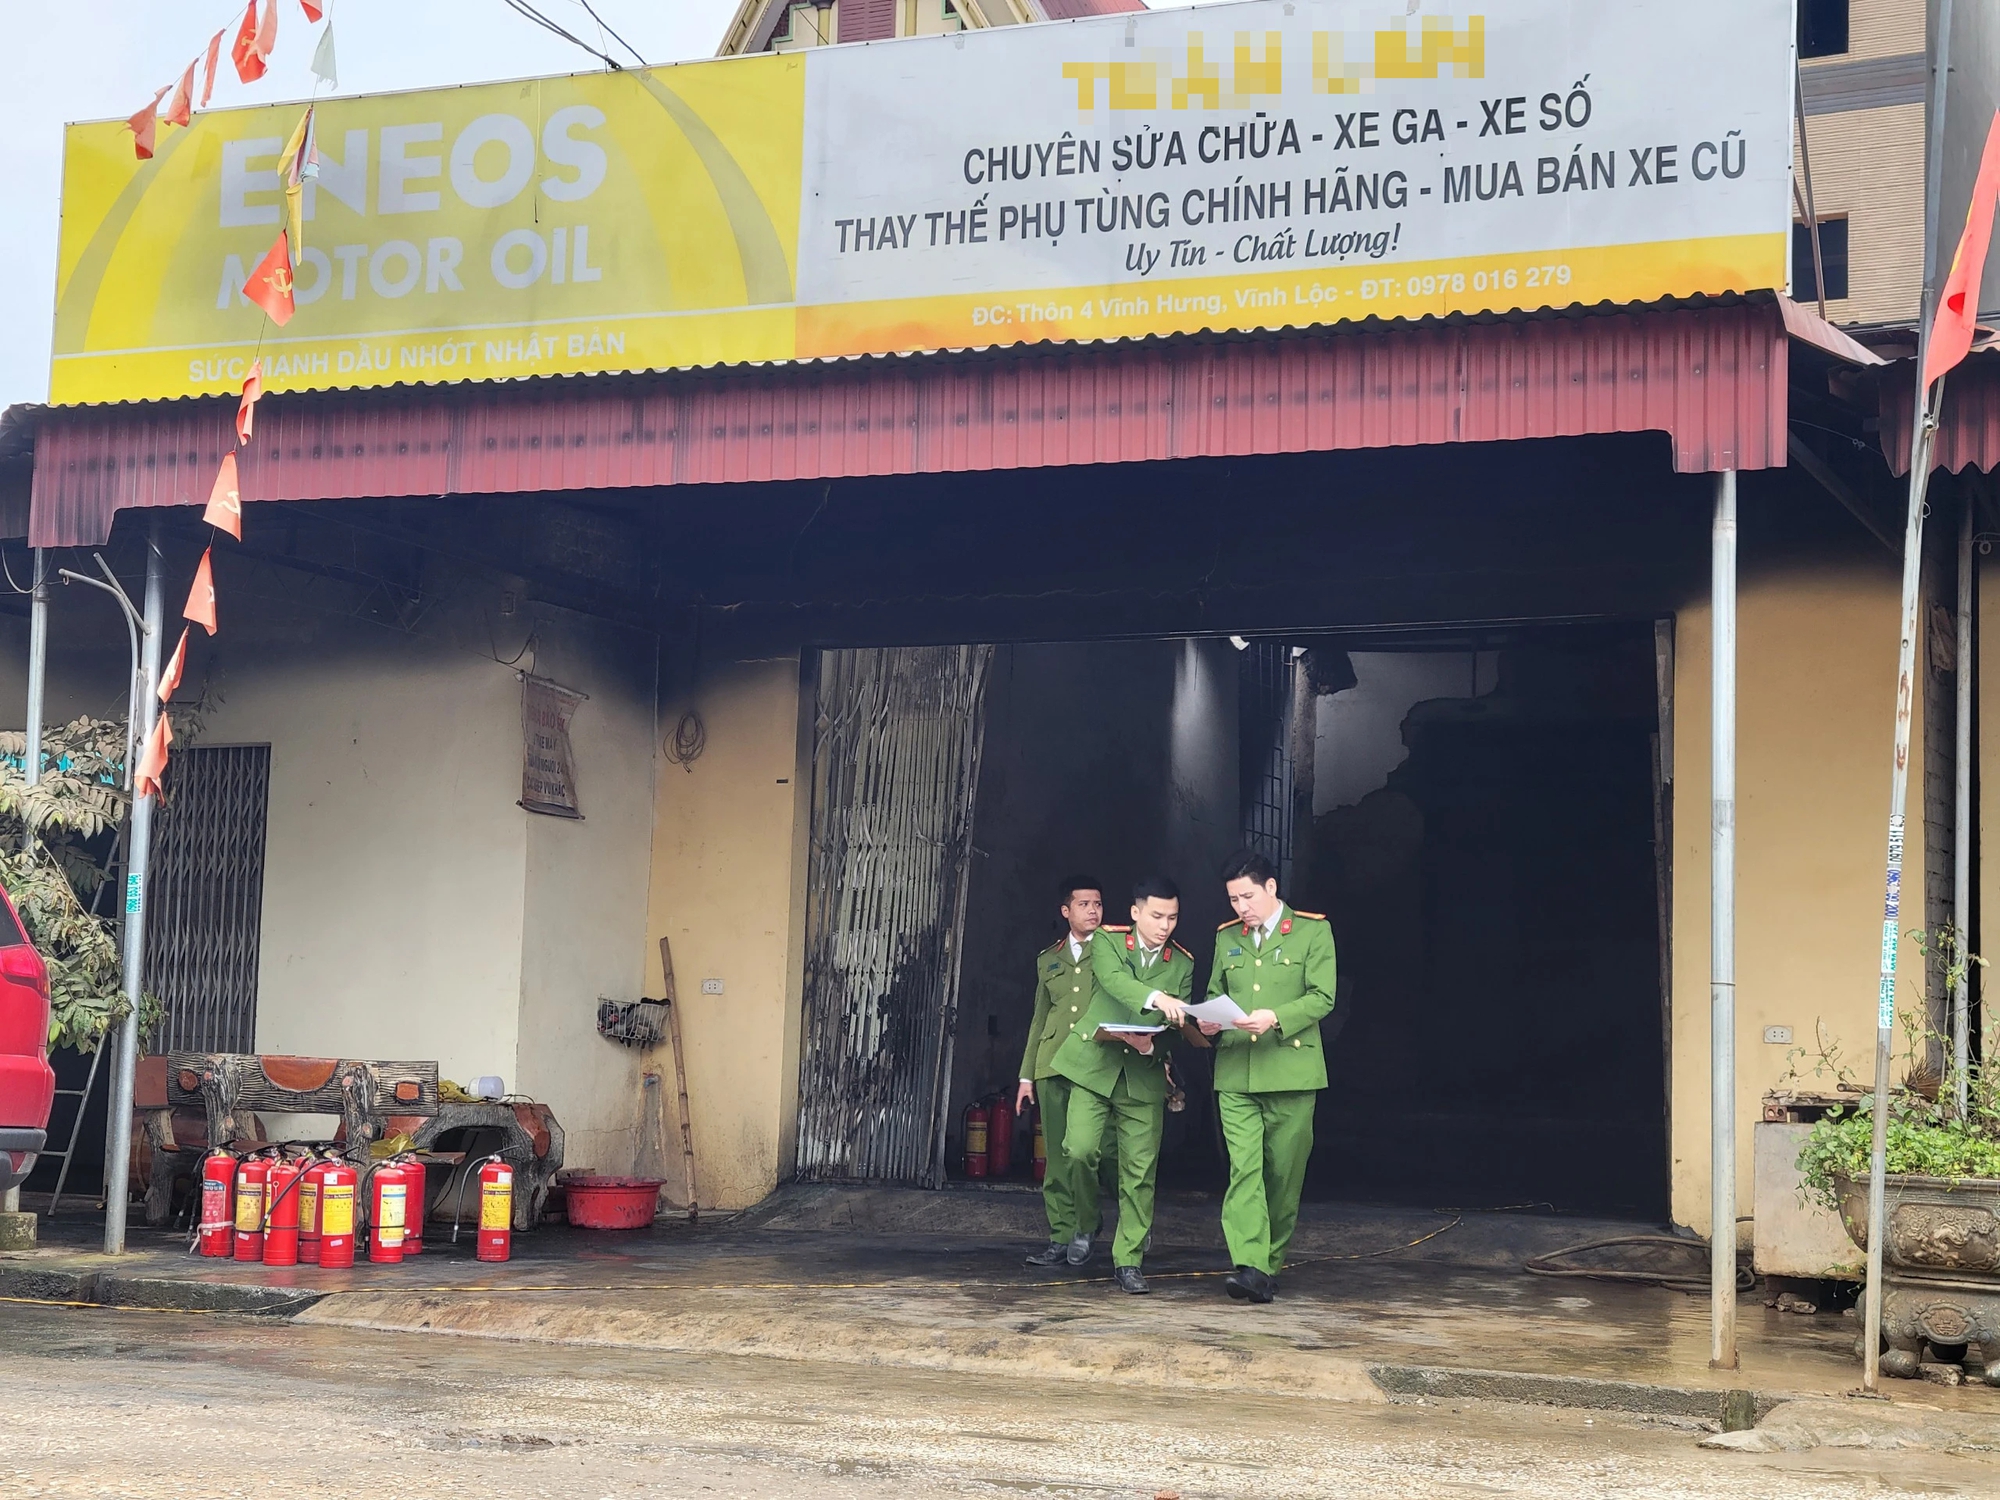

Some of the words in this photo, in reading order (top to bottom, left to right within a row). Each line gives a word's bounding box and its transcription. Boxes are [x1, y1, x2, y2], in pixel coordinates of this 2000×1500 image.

[218, 104, 608, 228] ENEOS
[963, 131, 1101, 185] CHUYÊN
[1111, 124, 1188, 172] SỬA
[1198, 111, 1302, 164] CHỮA
[1333, 111, 1380, 150] XE
[1391, 107, 1446, 146] GA
[1478, 96, 1527, 137] XE
[1538, 73, 1592, 132] SỐ
[834, 214, 918, 253] THAY
[924, 193, 990, 247] THẾ
[999, 200, 1066, 247] PHỤ
[1074, 187, 1170, 234] TÙNG
[1181, 175, 1291, 227] CHÍNH
[1303, 165, 1409, 216] HÃNG
[1443, 160, 1525, 204] MUA
[1536, 143, 1616, 195] BÁN
[1628, 144, 1679, 188] XE
[1691, 129, 1746, 182] CŨ
[216, 236, 465, 310] MOTOR
[490, 225, 602, 290] OIL
[1124, 243, 1161, 276] Uy
[1169, 239, 1208, 268] Tín
[1233, 227, 1297, 263] Chất
[1304, 222, 1402, 261] Lượng!
[1016, 302, 1074, 323] Thôn
[1079, 301, 1093, 320] 4
[1099, 297, 1150, 319] Vĩnh
[1156, 293, 1228, 315] Hưng,
[1234, 286, 1288, 308] Vĩnh
[1294, 283, 1339, 309] Lộc
[1360, 277, 1402, 300] ĐT:
[1406, 270, 1466, 299] 0978
[1472, 268, 1518, 293] 016
[1525, 264, 1572, 287] 279
[188, 353, 245, 383] SỨC
[337, 340, 397, 374] DẦU
[400, 337, 477, 369] NHỚT
[484, 331, 561, 367] NHẬT
[567, 326, 626, 358] BẢN
